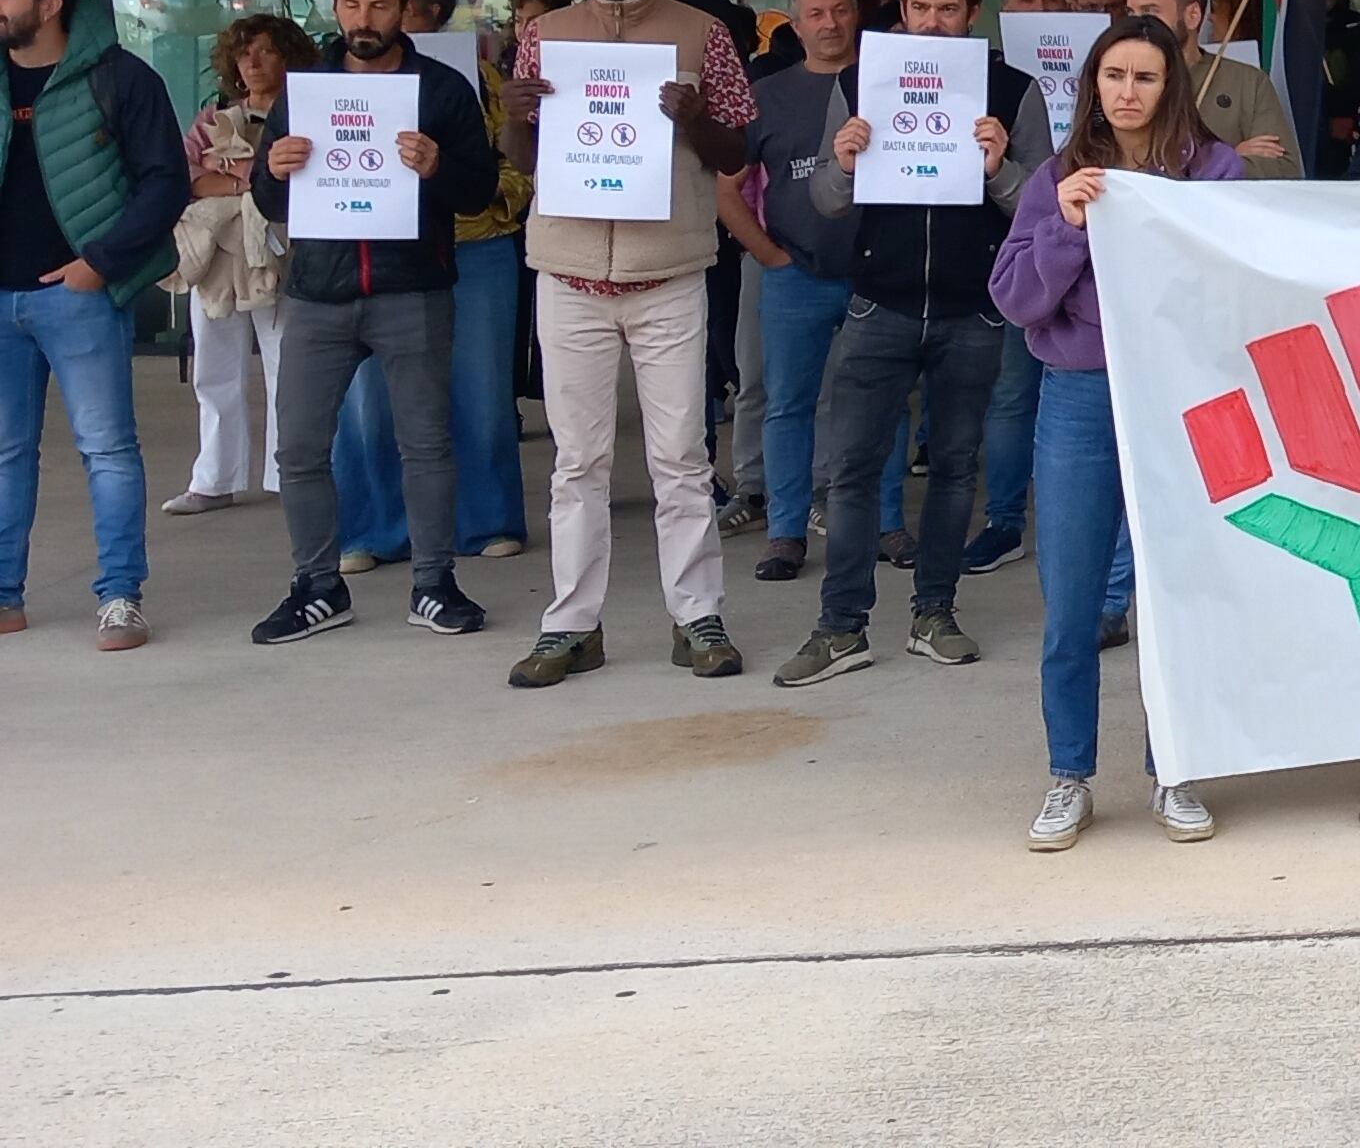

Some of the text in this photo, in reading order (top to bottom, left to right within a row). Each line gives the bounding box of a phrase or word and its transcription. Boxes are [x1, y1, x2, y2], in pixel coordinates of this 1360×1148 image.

[1036, 48, 1073, 60] BOIKOTA
[904, 61, 938, 74] ISRAELI
[590, 69, 625, 82] ISRAELI
[899, 76, 943, 89] BOIKOTA
[585, 84, 630, 99] BOIKOTA
[903, 92, 939, 104] ORAIN!
[334, 99, 369, 112] ISRAELI
[589, 101, 625, 115] ORAIN!
[331, 114, 375, 127] BOIKOTA
[336, 129, 371, 142] ORAIN!
